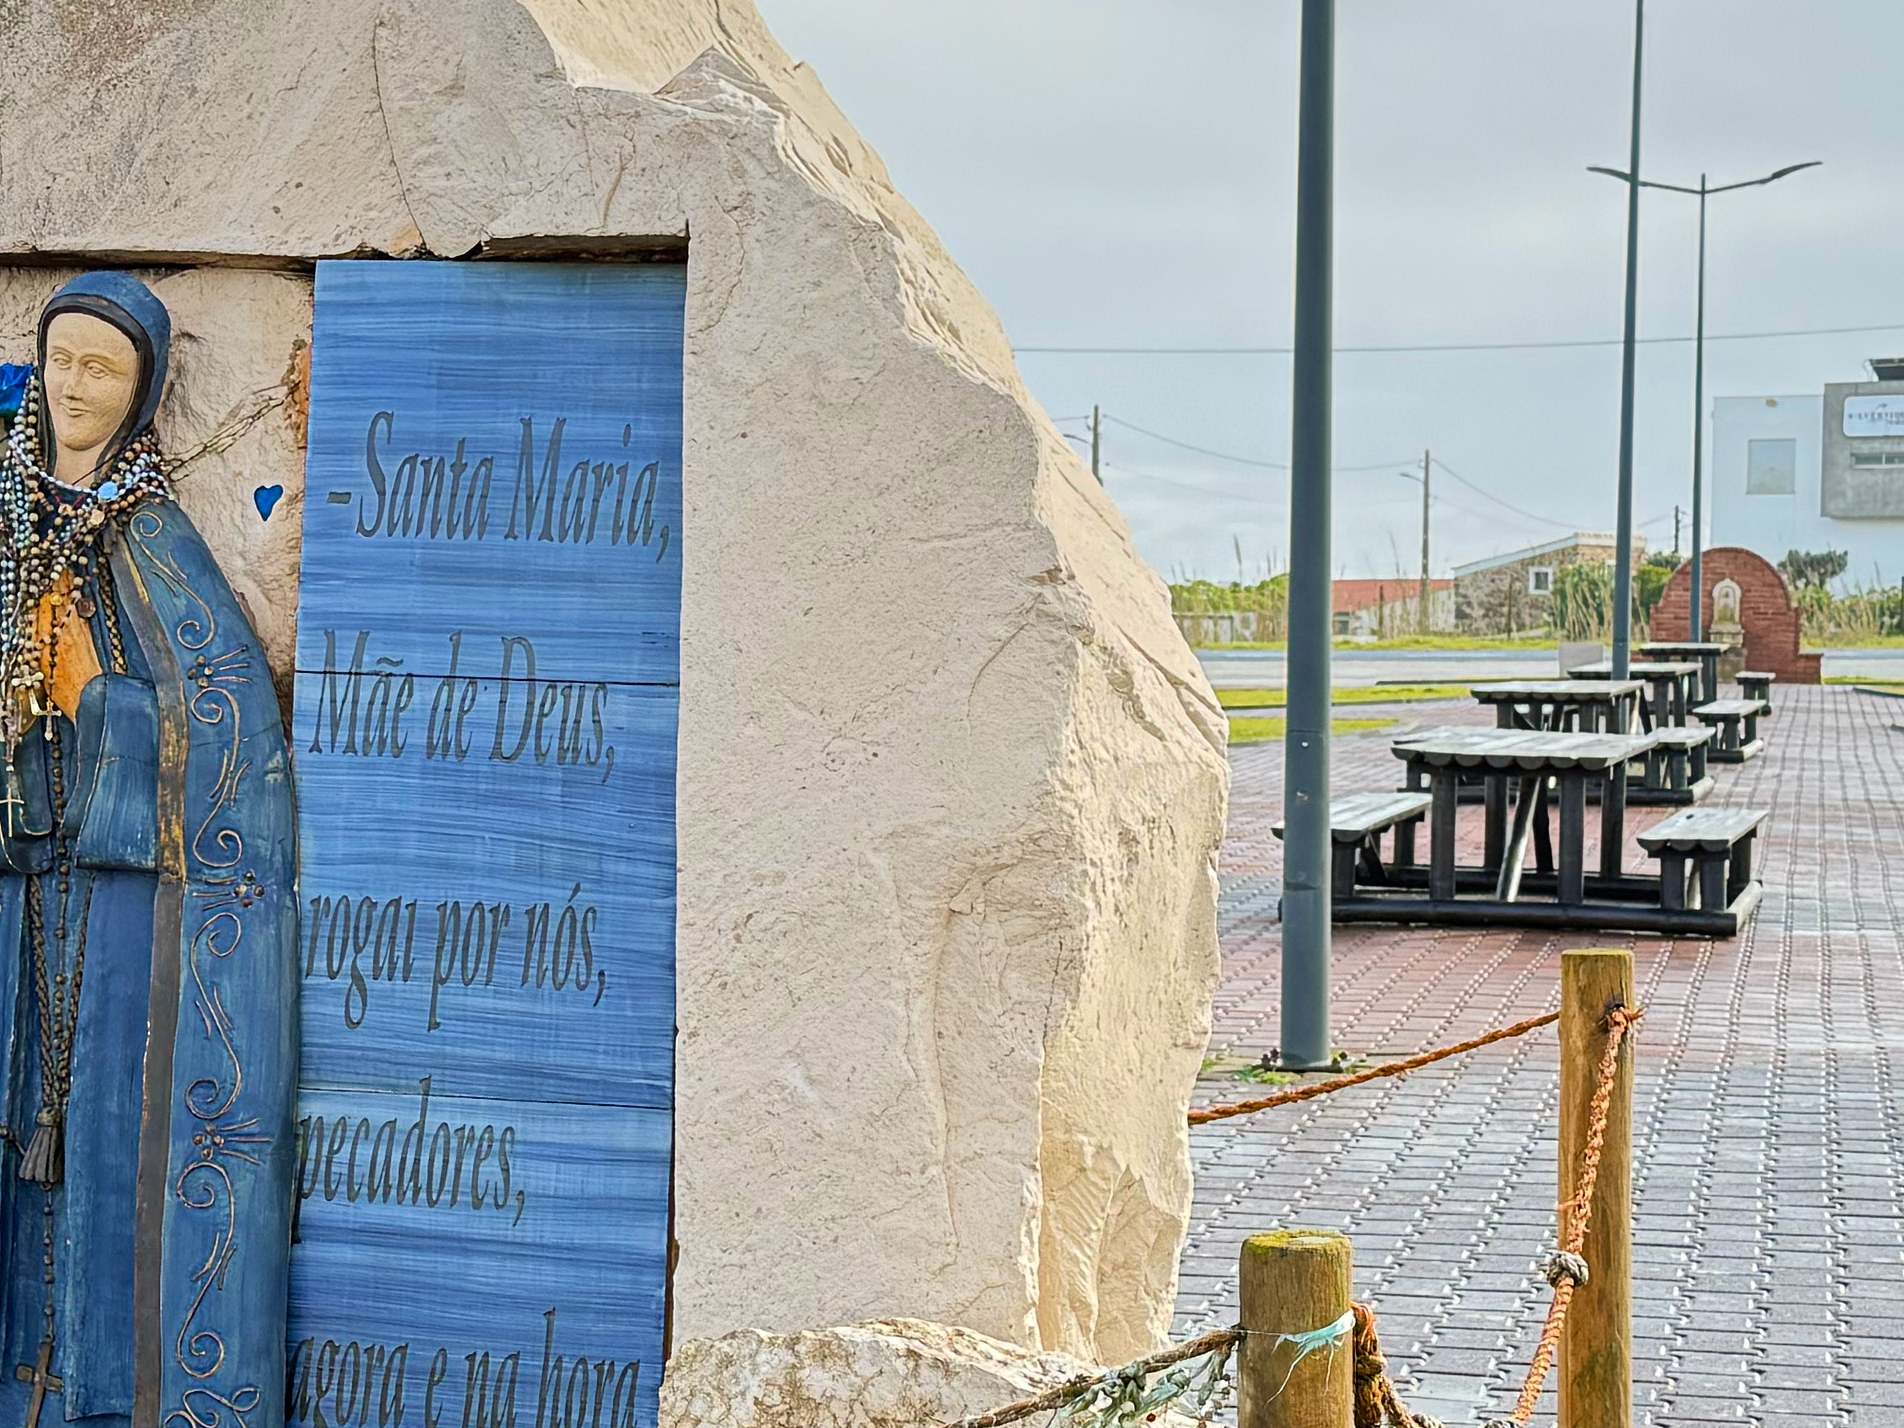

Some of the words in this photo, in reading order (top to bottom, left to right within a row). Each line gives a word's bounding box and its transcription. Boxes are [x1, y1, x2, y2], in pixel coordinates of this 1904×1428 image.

[504, 415, 670, 563] Maria,
[308, 629, 414, 759] Mãe
[426, 630, 478, 762] de
[488, 635, 615, 785] Deus,
[427, 900, 510, 1033] por
[521, 882, 606, 1007] nós,
[294, 1073, 525, 1244] pecadores,
